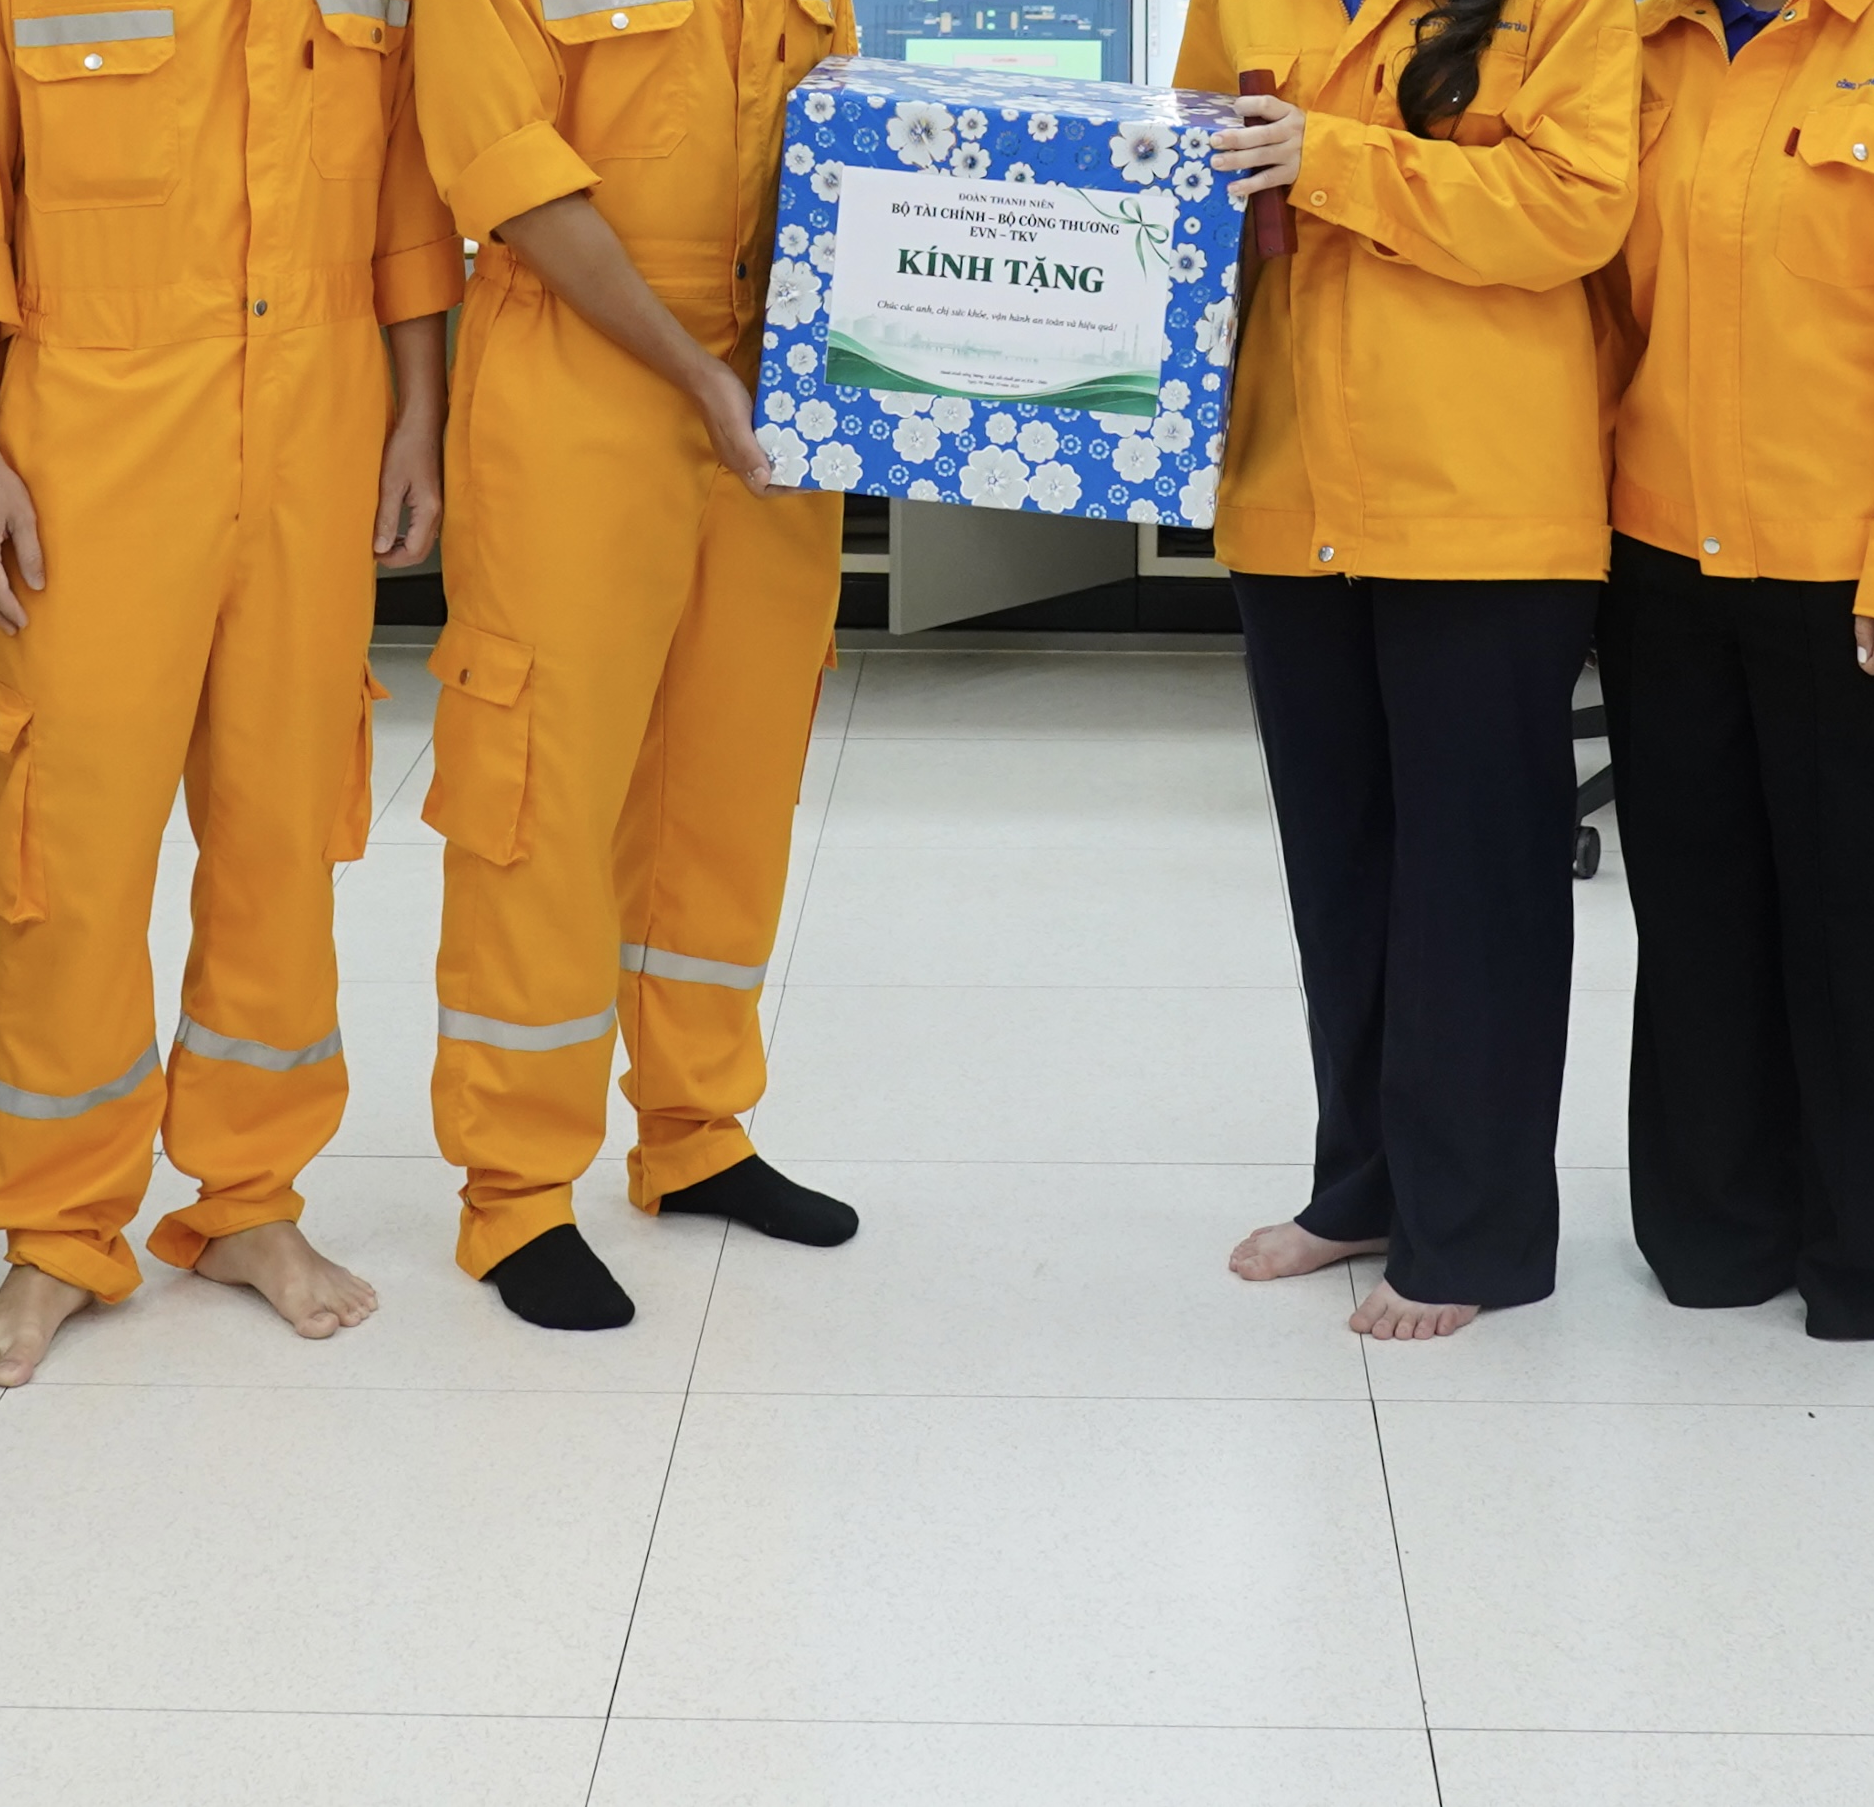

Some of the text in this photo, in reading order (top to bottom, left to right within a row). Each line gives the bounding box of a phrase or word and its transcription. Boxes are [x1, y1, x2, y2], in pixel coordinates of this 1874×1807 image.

[959, 192, 1056, 210] ĐOÀN THANH NIÊN
[891, 200, 911, 217] BỘ
[914, 203, 937, 218] TÀI
[940, 205, 986, 224] CHÍNH
[997, 211, 1016, 228] BỘ
[1018, 212, 1056, 230] CÔNG
[1059, 218, 1120, 236] THƯƠNG
[969, 226, 998, 240] EVN
[1009, 229, 1038, 243] TKV
[896, 245, 1105, 294] KÍNH TẶNG
[876, 299, 899, 311] Chúc
[900, 302, 914, 313] các
[915, 304, 935, 315] anh,
[936, 305, 949, 317] chị
[951, 307, 966, 318] sức
[967, 308, 989, 321] khỏe,
[991, 312, 1007, 323] vận
[1008, 313, 1030, 324] hành
[1032, 317, 1044, 325] an
[1045, 316, 1064, 327] toàn
[1066, 317, 1076, 328] và
[1077, 319, 1096, 331] hiệu
